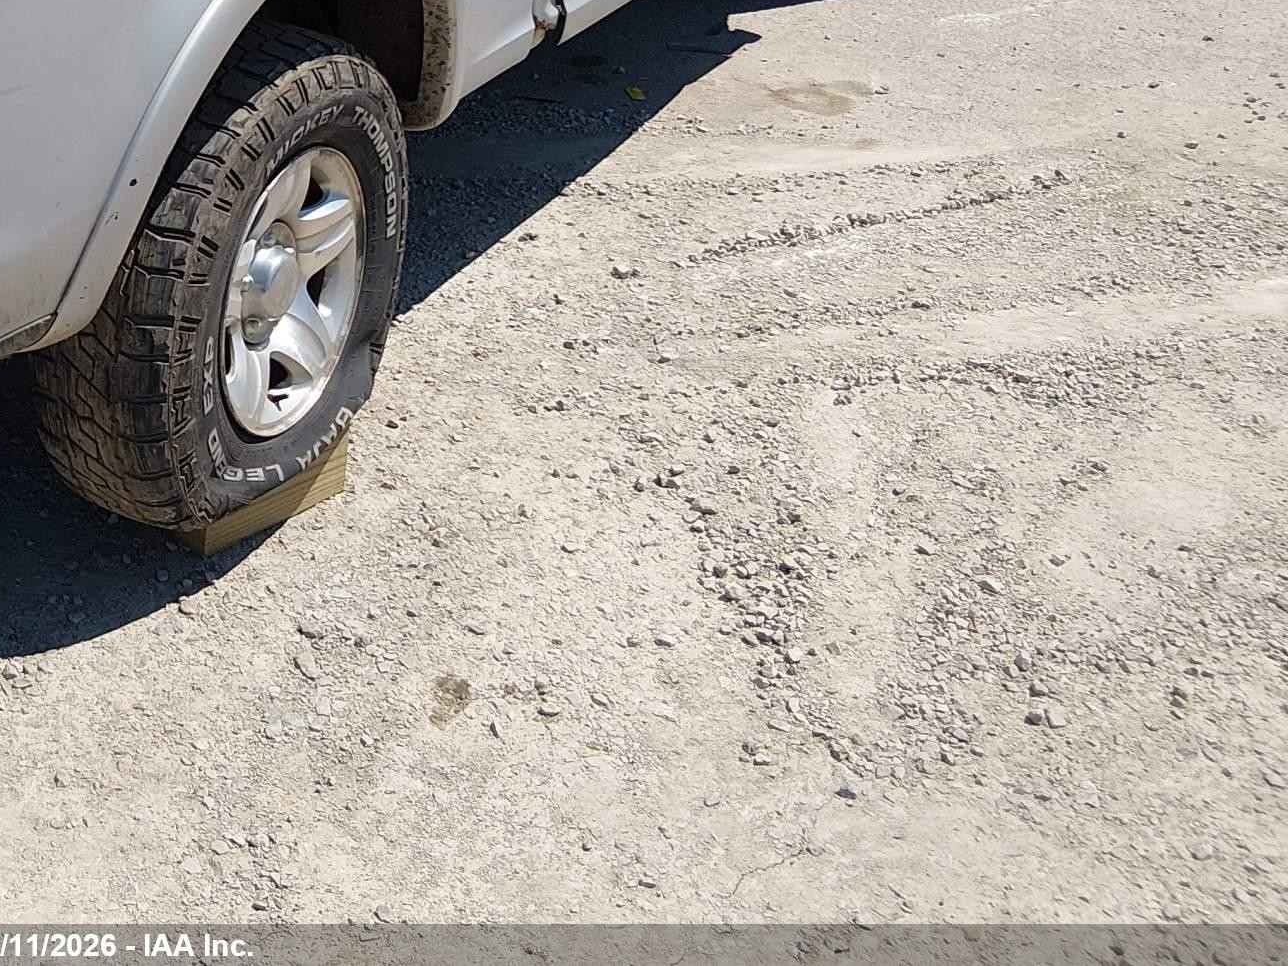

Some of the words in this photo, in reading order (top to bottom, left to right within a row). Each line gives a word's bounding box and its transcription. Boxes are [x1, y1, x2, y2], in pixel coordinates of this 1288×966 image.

[266, 104, 344, 178] MICKEY
[352, 106, 397, 238] THOMPSON
[203, 336, 213, 416] EXP
[207, 428, 285, 482] LEGEND
